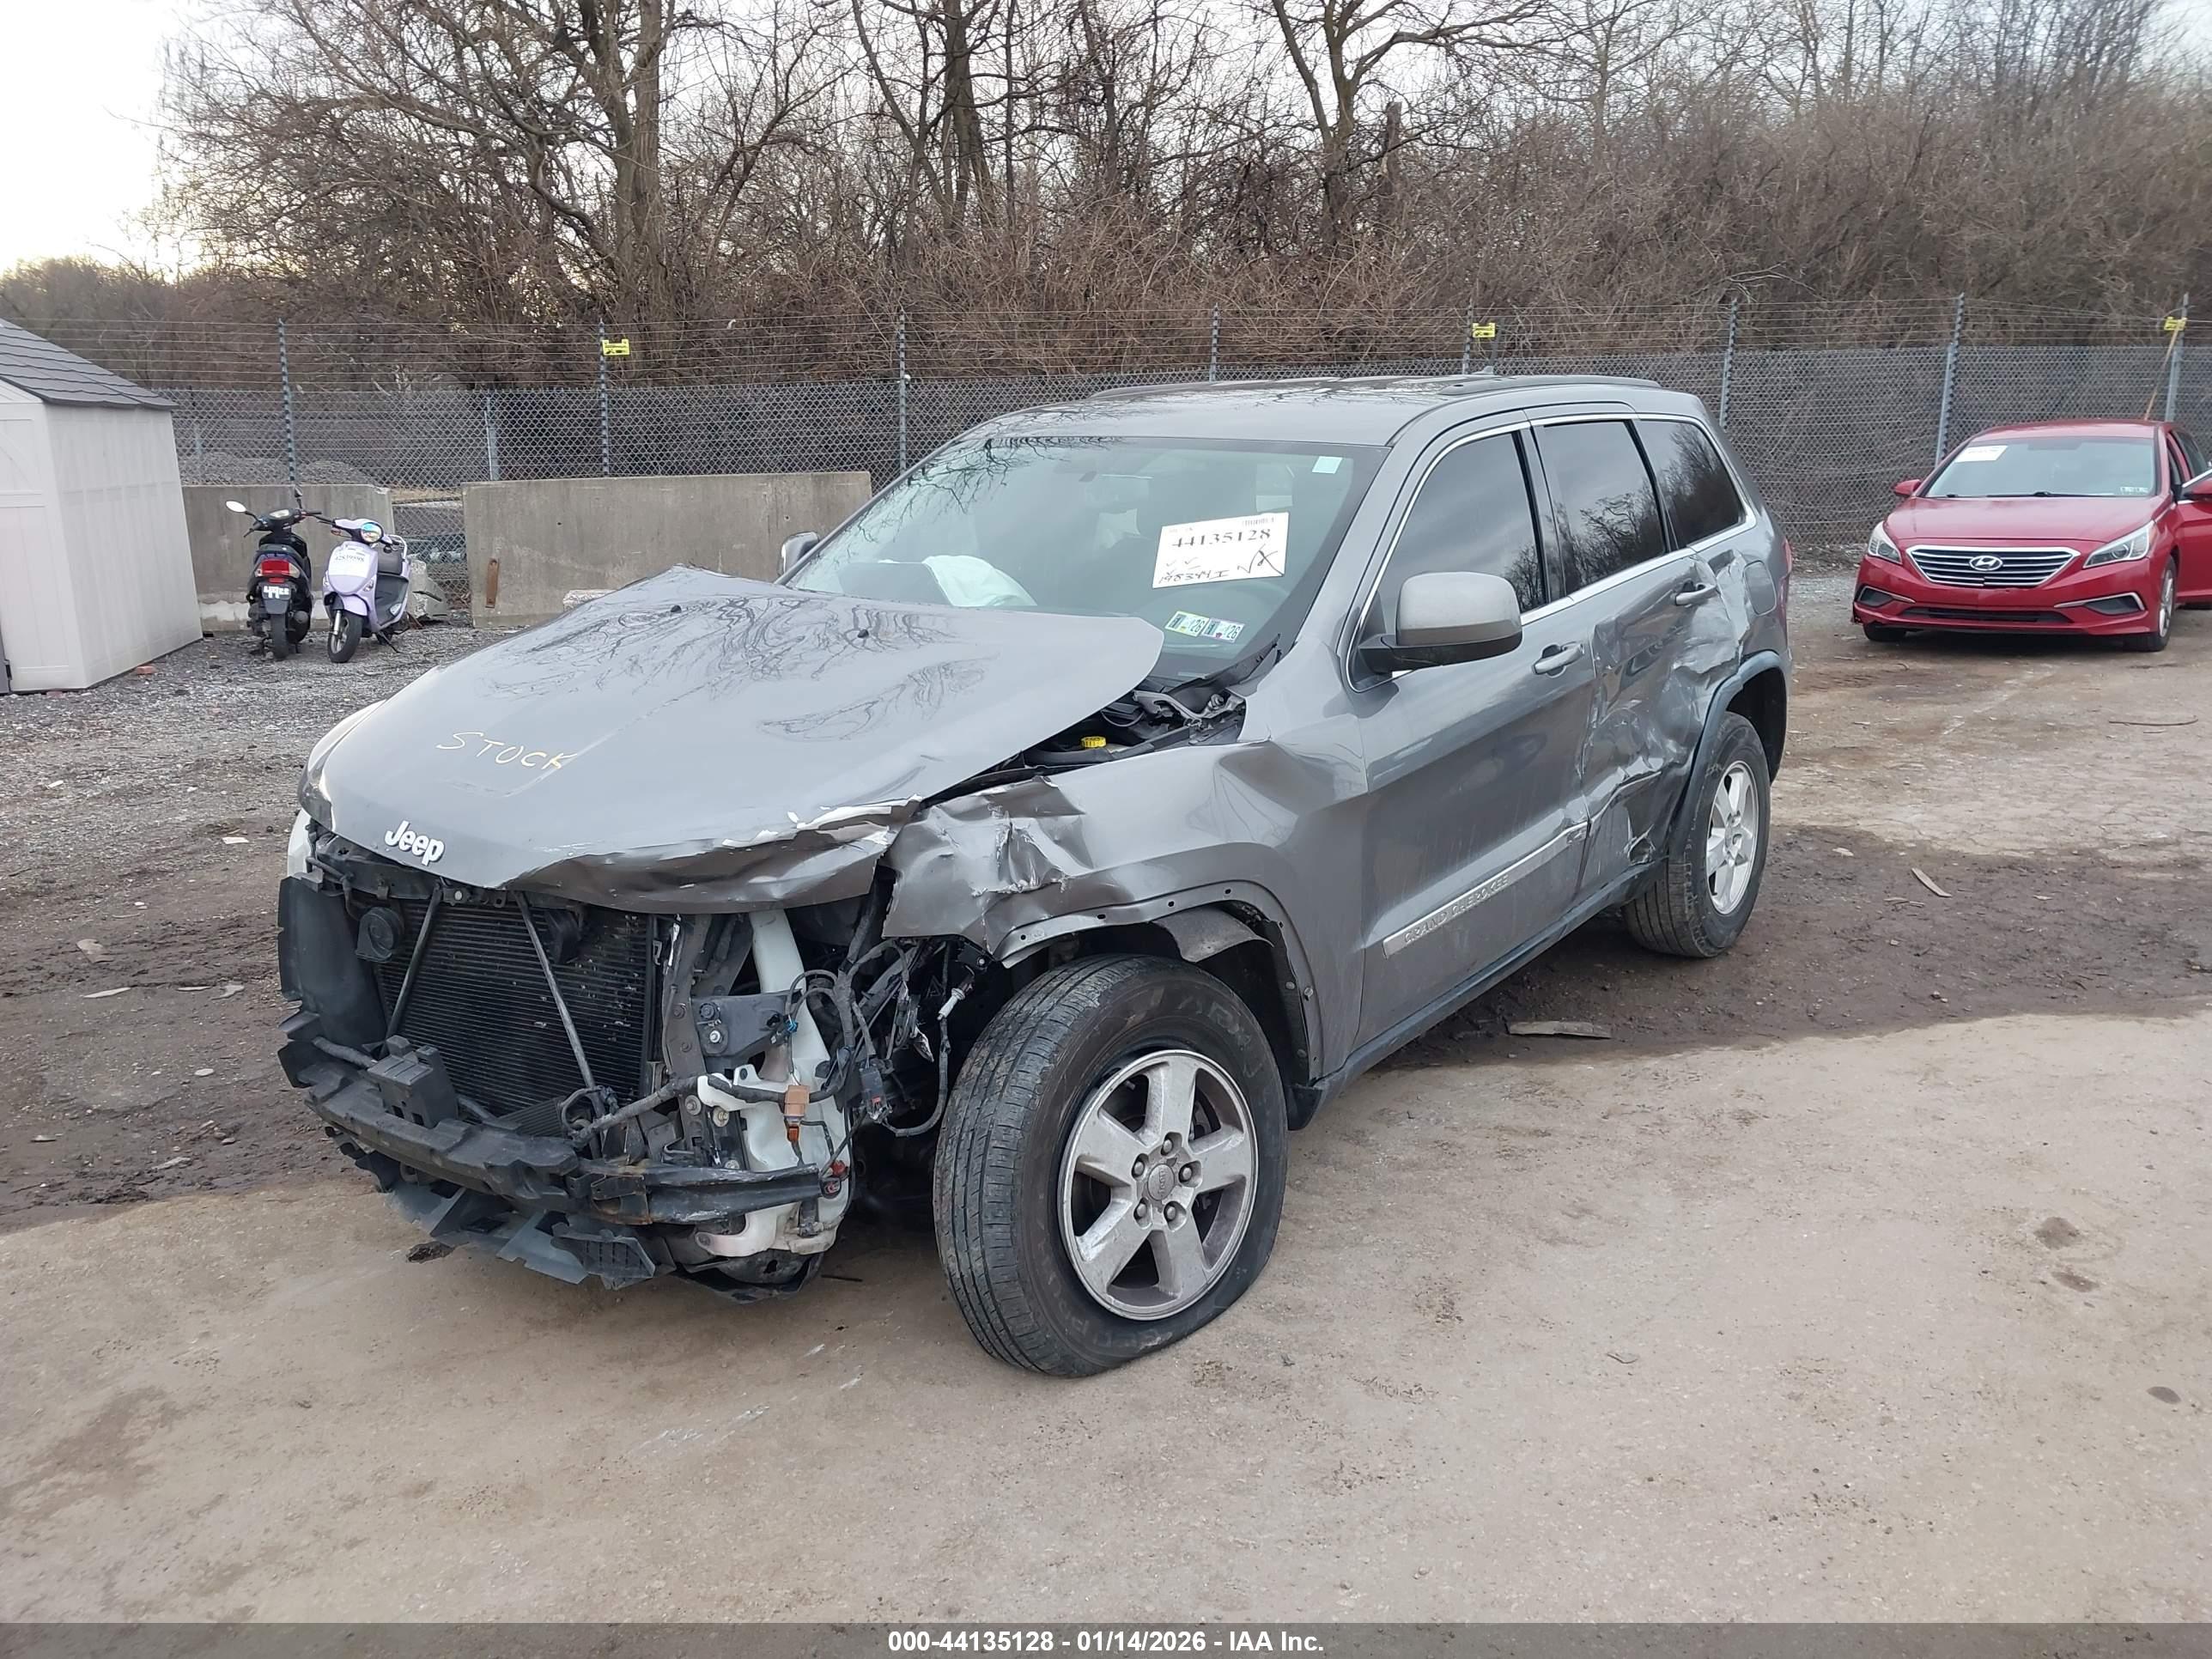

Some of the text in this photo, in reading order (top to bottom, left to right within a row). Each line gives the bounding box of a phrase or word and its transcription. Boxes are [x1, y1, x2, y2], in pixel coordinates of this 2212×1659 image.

[1171, 528, 1271, 547] 44135128
[435, 732, 578, 770] STOCK
[384, 820, 445, 866] Jeep
[1405, 912, 1448, 944] GRAND
